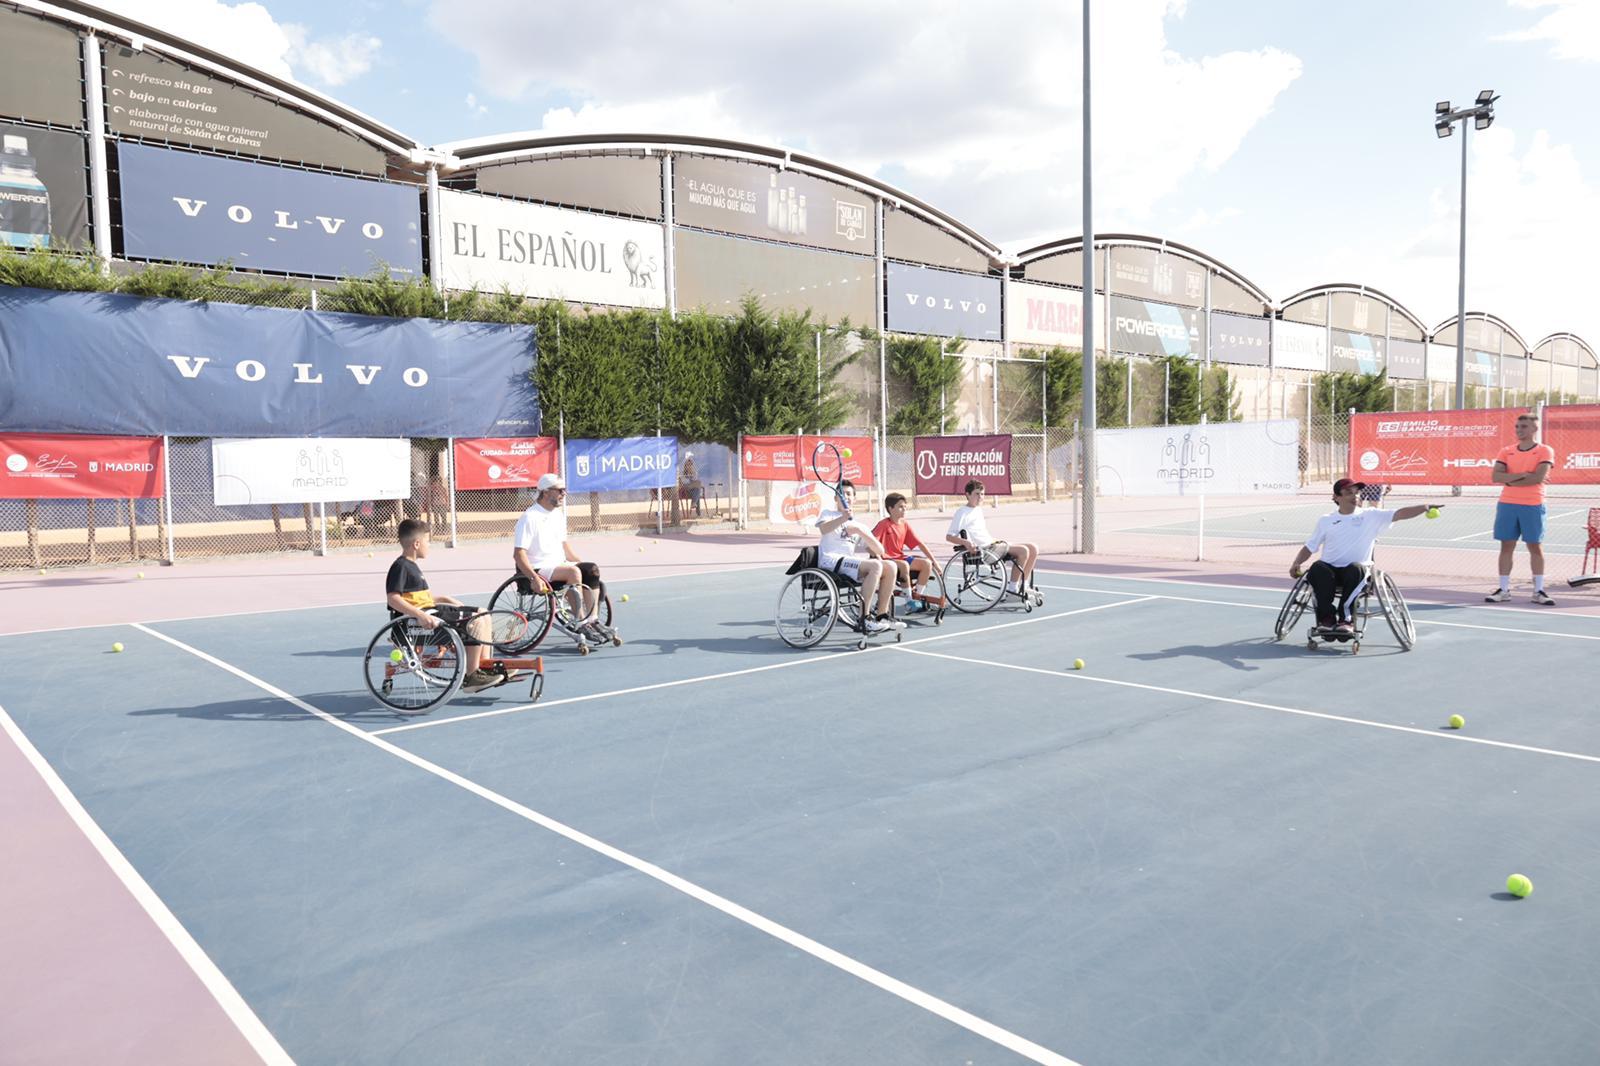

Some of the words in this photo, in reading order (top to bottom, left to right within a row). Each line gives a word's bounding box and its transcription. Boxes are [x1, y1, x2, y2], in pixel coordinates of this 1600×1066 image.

[128, 71, 172, 87] refresco
[174, 78, 191, 91] sin
[192, 84, 213, 95] gas
[129, 90, 155, 103] bajo
[157, 96, 170, 105] en
[172, 98, 217, 113] calorías
[128, 107, 183, 124] elaborado
[185, 118, 203, 128] con
[205, 121, 230, 132] agua
[232, 126, 269, 139] mineral
[129, 119, 169, 132] natural
[170, 124, 182, 135] de
[183, 126, 212, 139] Solán
[213, 131, 225, 142] de
[227, 133, 261, 147] Cabras
[0, 192, 47, 204] WERADE
[700, 183, 725, 196] AGUA
[727, 187, 744, 200] QUE
[746, 191, 757, 202] ES
[689, 193, 712, 206] MUCHO
[727, 200, 739, 211] QUE
[740, 203, 757, 214] AGUA
[173, 197, 384, 240] VOLVO
[452, 221, 486, 258] EL
[497, 228, 612, 274] ESPAÑOL
[906, 293, 987, 314] VOLVO
[1116, 316, 1186, 341] POWERADE
[1220, 334, 1262, 346] VOLVO
[167, 354, 429, 388] VOLVO
[1452, 425, 1498, 433] academy
[601, 454, 671, 473] MADRID
[943, 448, 1003, 464] FEDERACIÓN
[1575, 455, 1600, 467] Nutr
[105, 462, 154, 473] MADRID
[939, 465, 965, 477] TENIS
[967, 465, 1005, 477] MADRID
[1157, 468, 1215, 480] MADRID
[293, 477, 349, 488] MADRID
